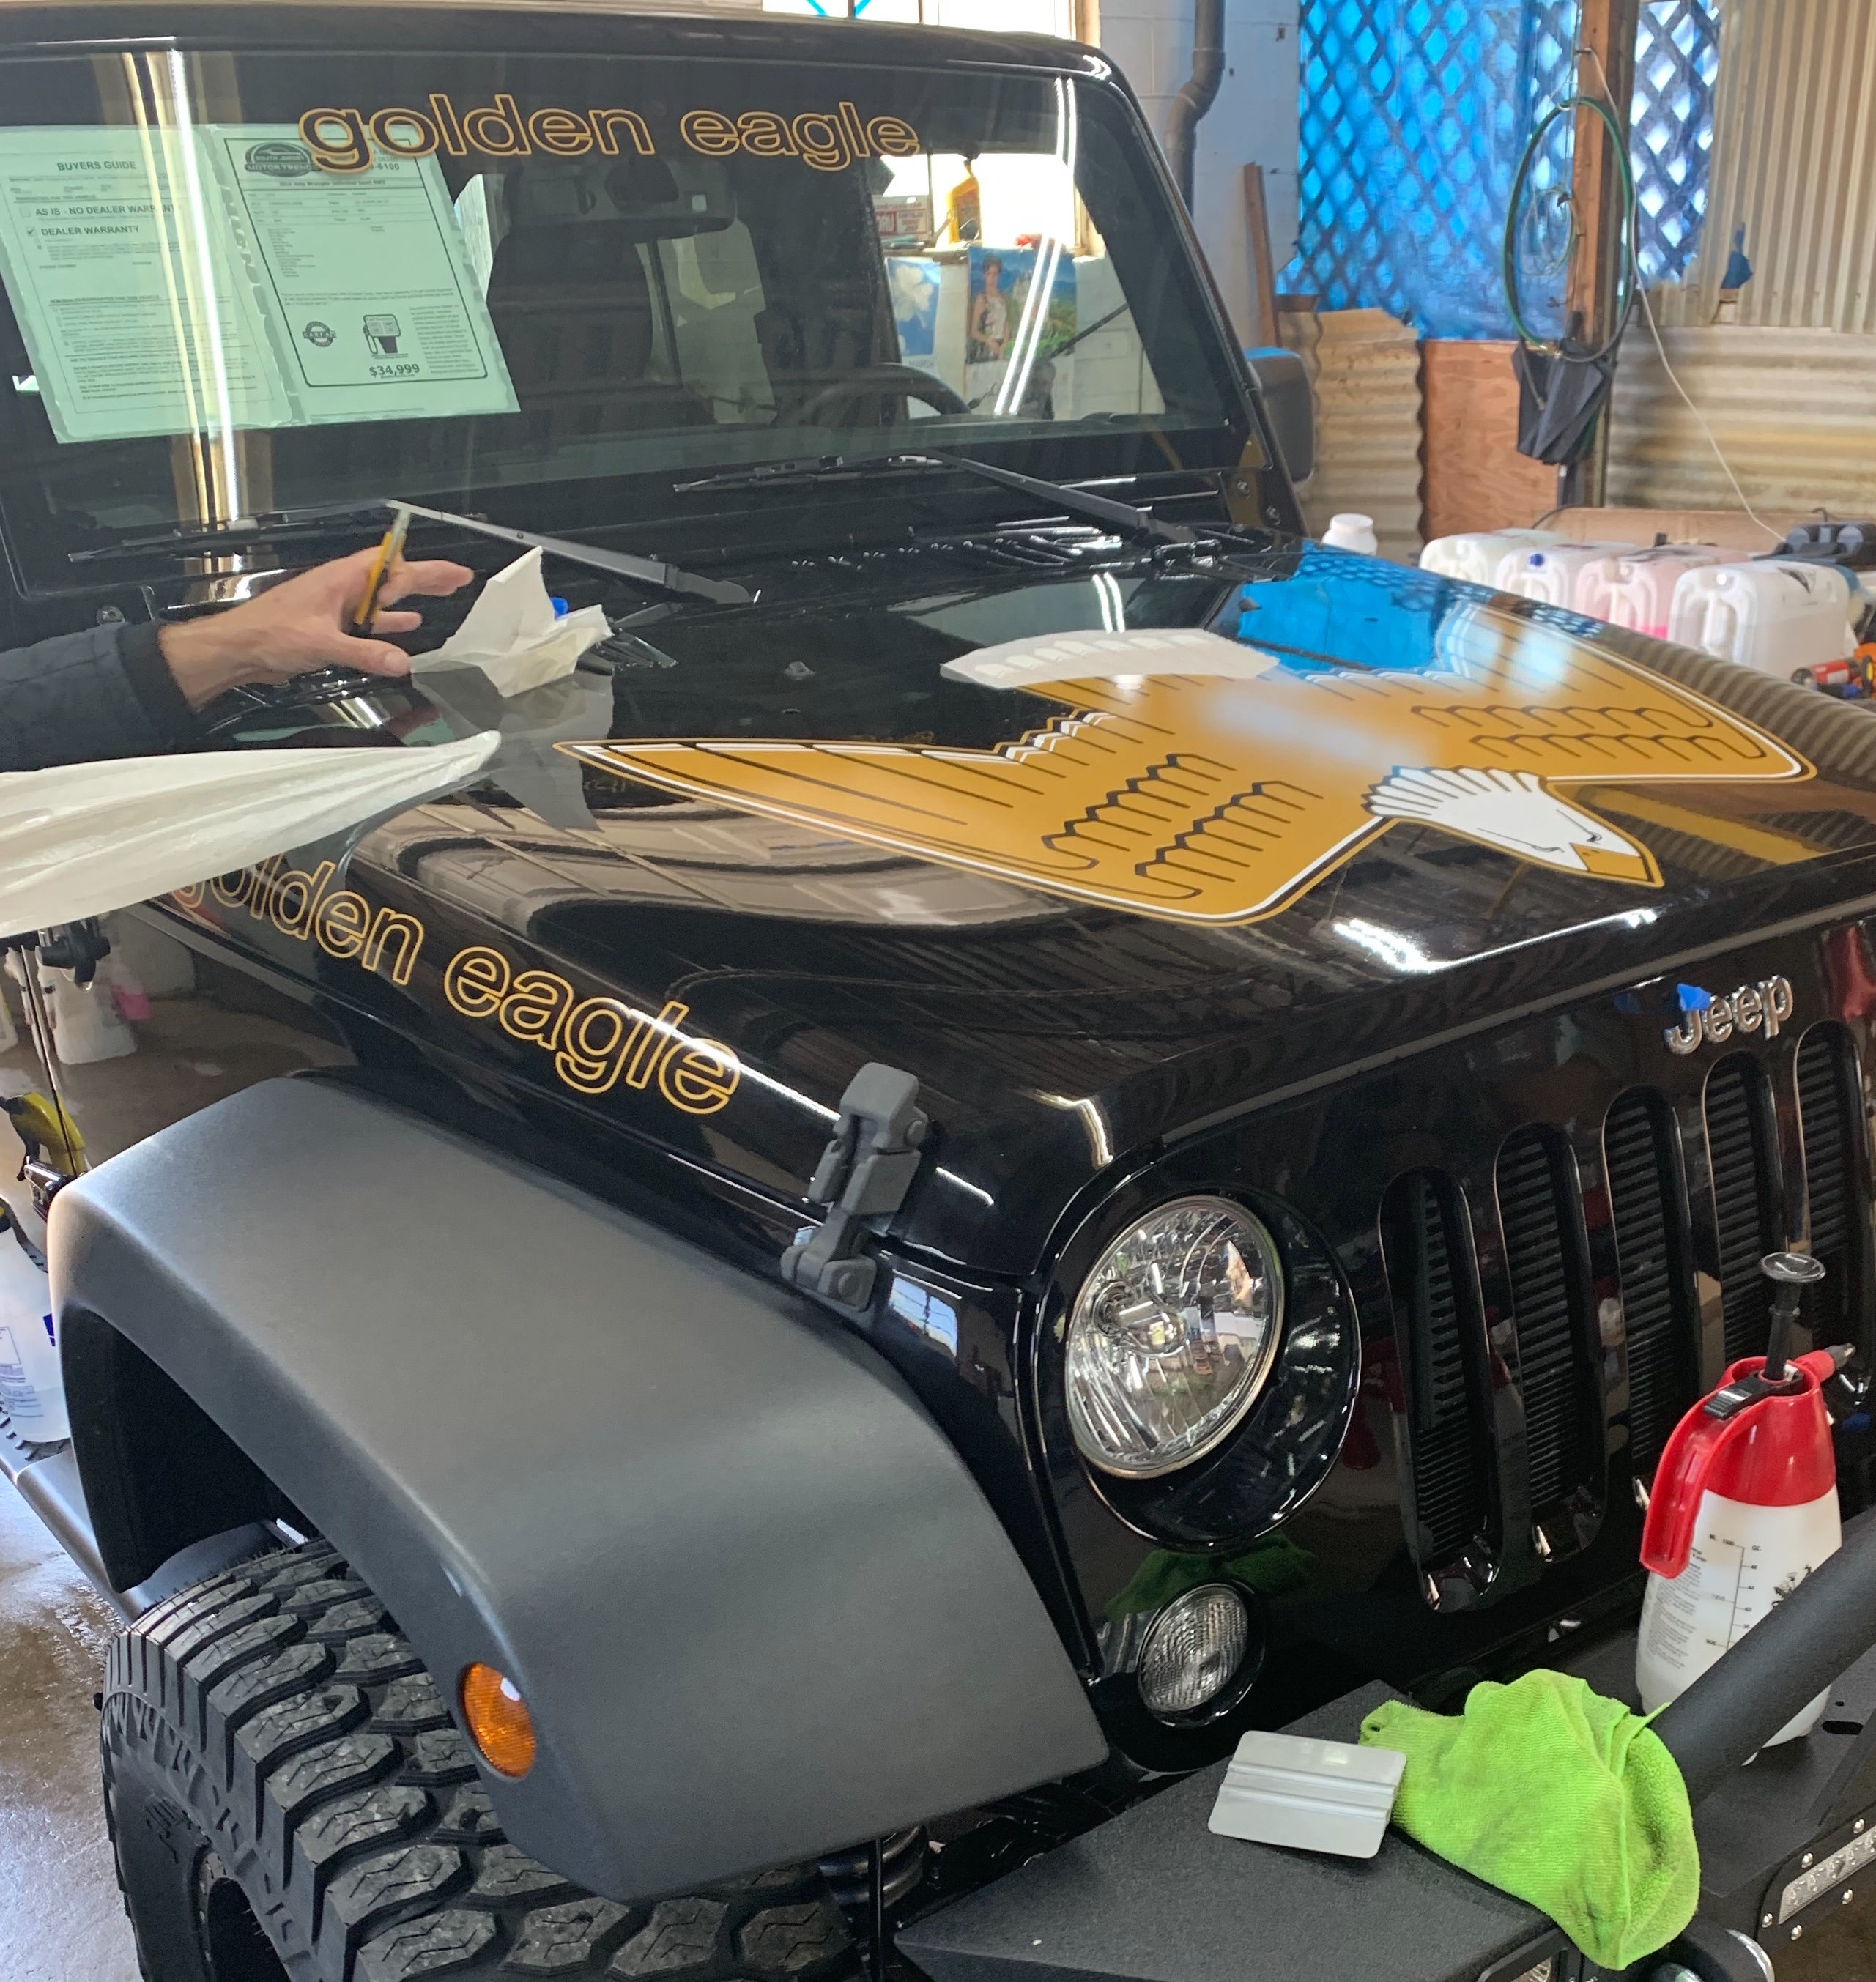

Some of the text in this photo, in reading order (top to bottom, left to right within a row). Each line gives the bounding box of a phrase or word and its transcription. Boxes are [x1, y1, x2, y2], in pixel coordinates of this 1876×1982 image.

[298, 93, 921, 173] golden eagle
[57, 160, 137, 171] BUYERS GUIDE
[86, 205, 125, 214] DEALER
[41, 225, 139, 236] DEALER WARRANTY
[369, 364, 420, 378] $34,999
[1664, 974, 1794, 1055] Jeep
[444, 946, 741, 1116] eagle
